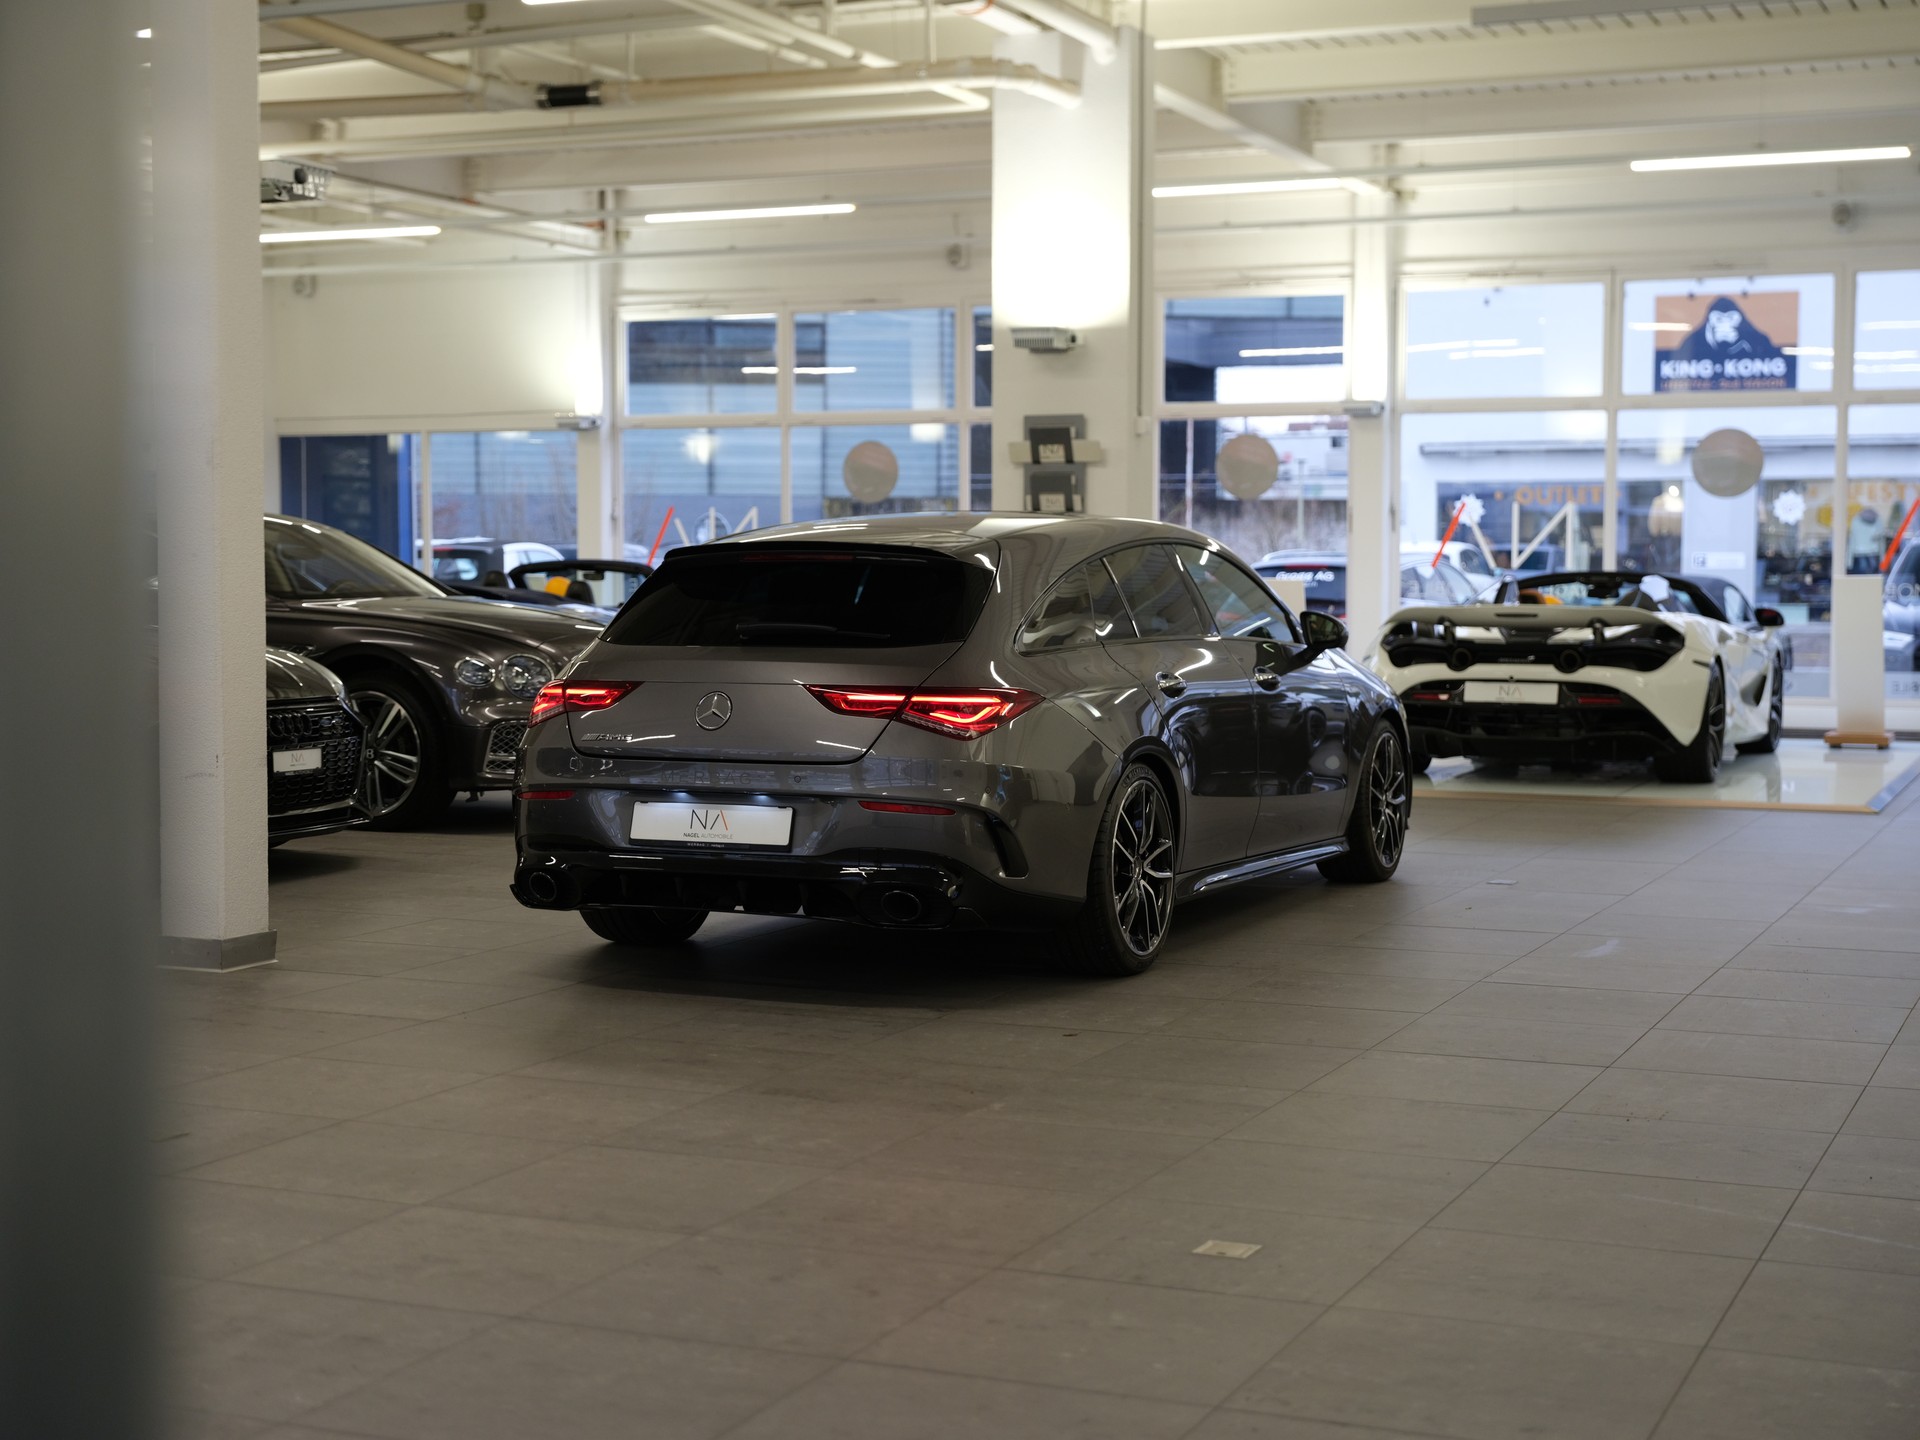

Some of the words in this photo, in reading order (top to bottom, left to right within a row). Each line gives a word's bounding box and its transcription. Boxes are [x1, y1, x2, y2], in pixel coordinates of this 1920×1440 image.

[1660, 359, 1714, 379] KING
[1724, 357, 1787, 378] KONG
[1515, 485, 1605, 505] OUTLET
[690, 809, 729, 831] NA
